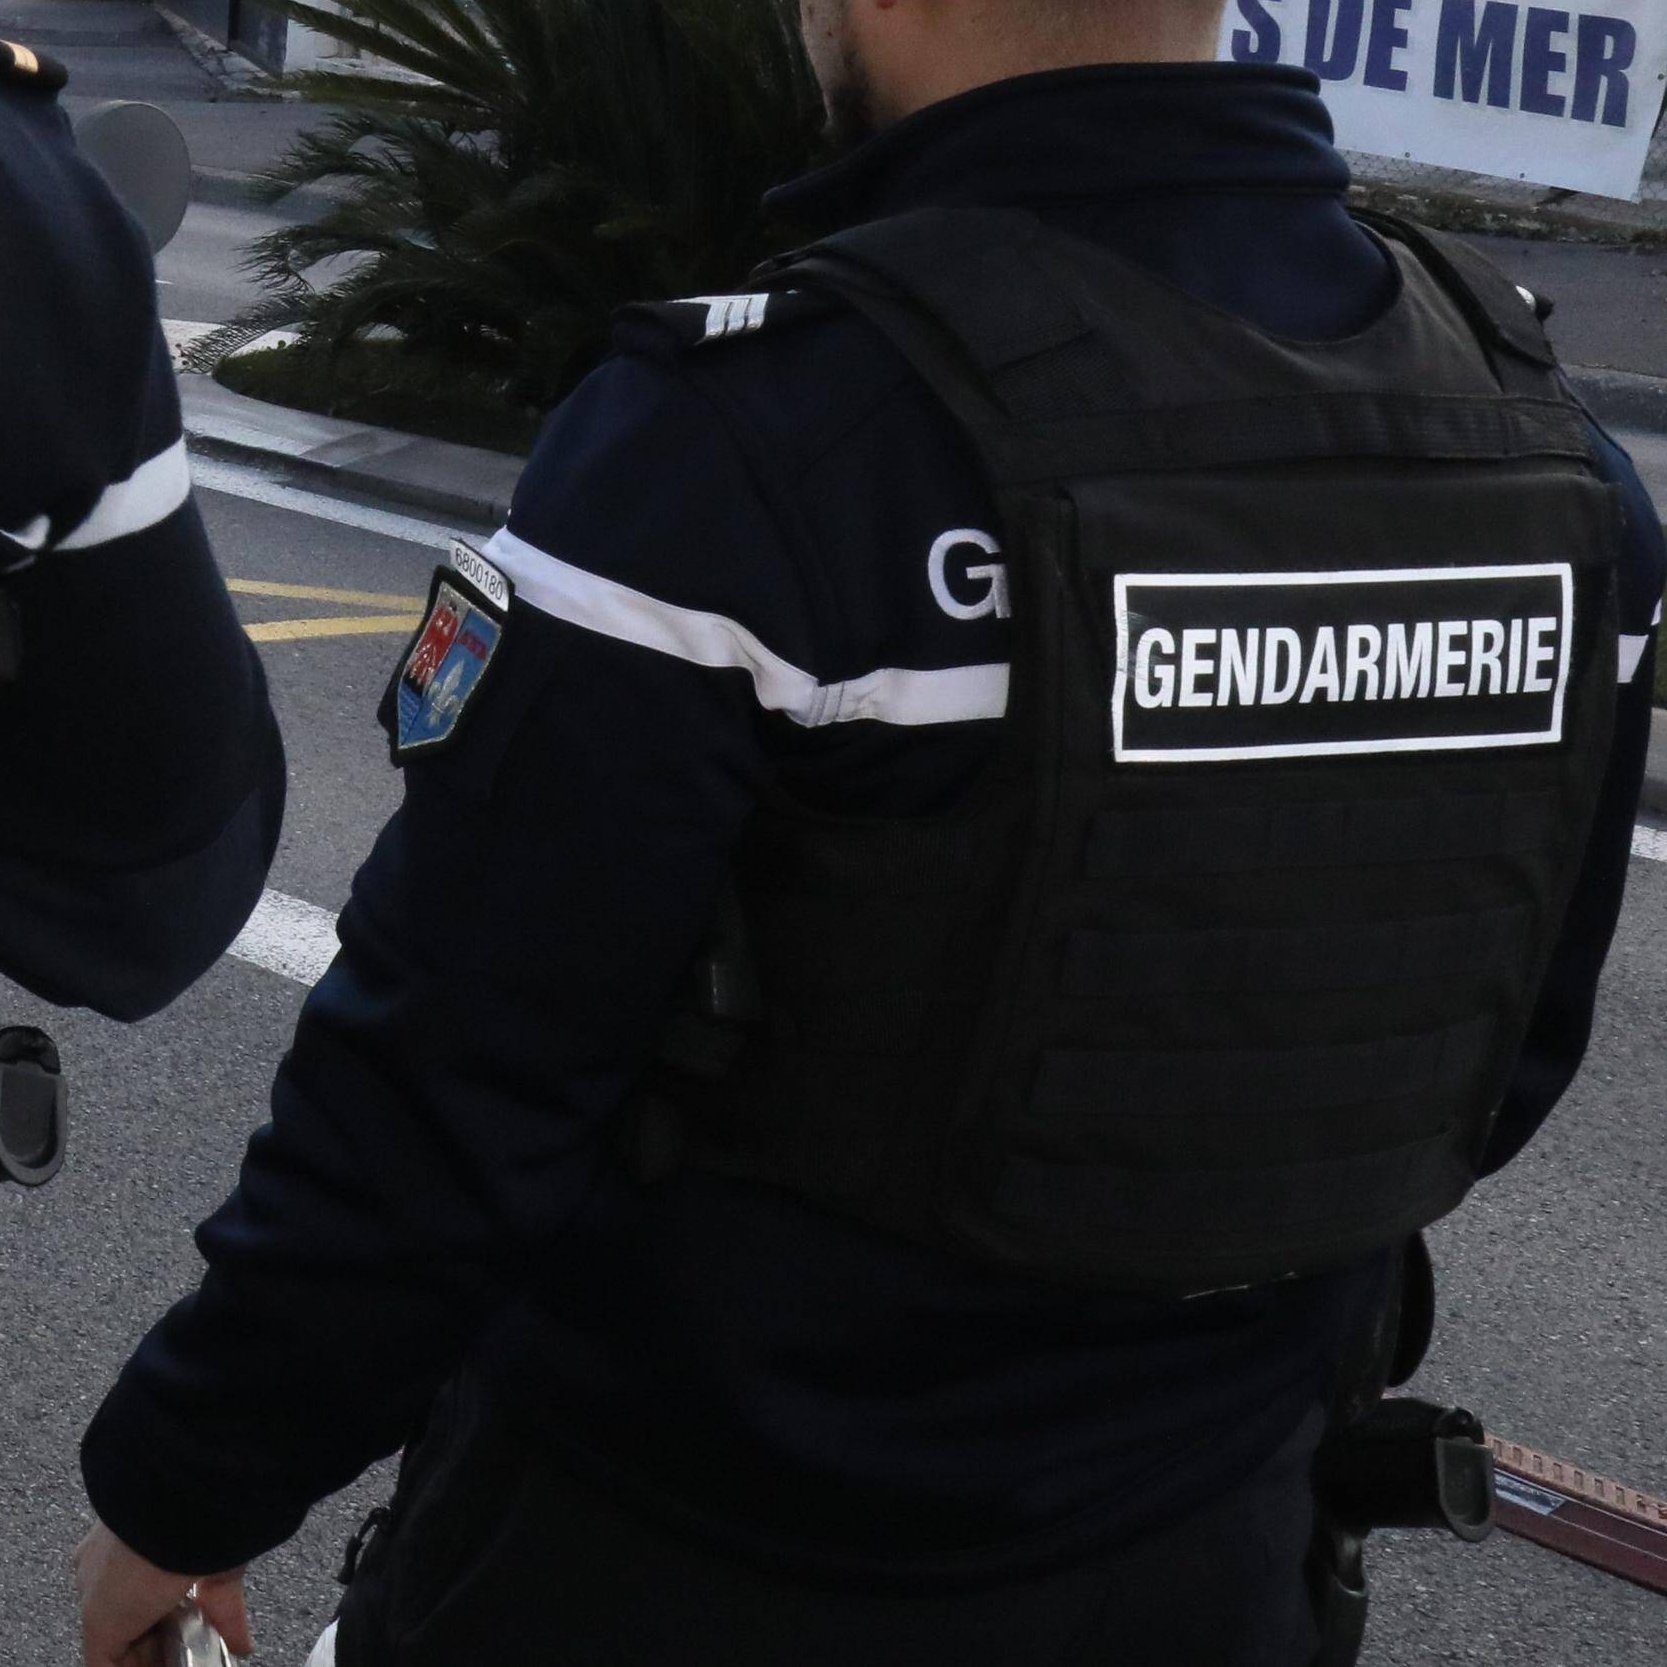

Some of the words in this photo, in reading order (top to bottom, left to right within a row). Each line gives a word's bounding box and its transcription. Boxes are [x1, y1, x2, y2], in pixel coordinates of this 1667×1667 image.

[454, 546, 504, 601] 6800180
[927, 528, 1011, 621] G
[1133, 616, 1558, 709] GENDARMERIE
